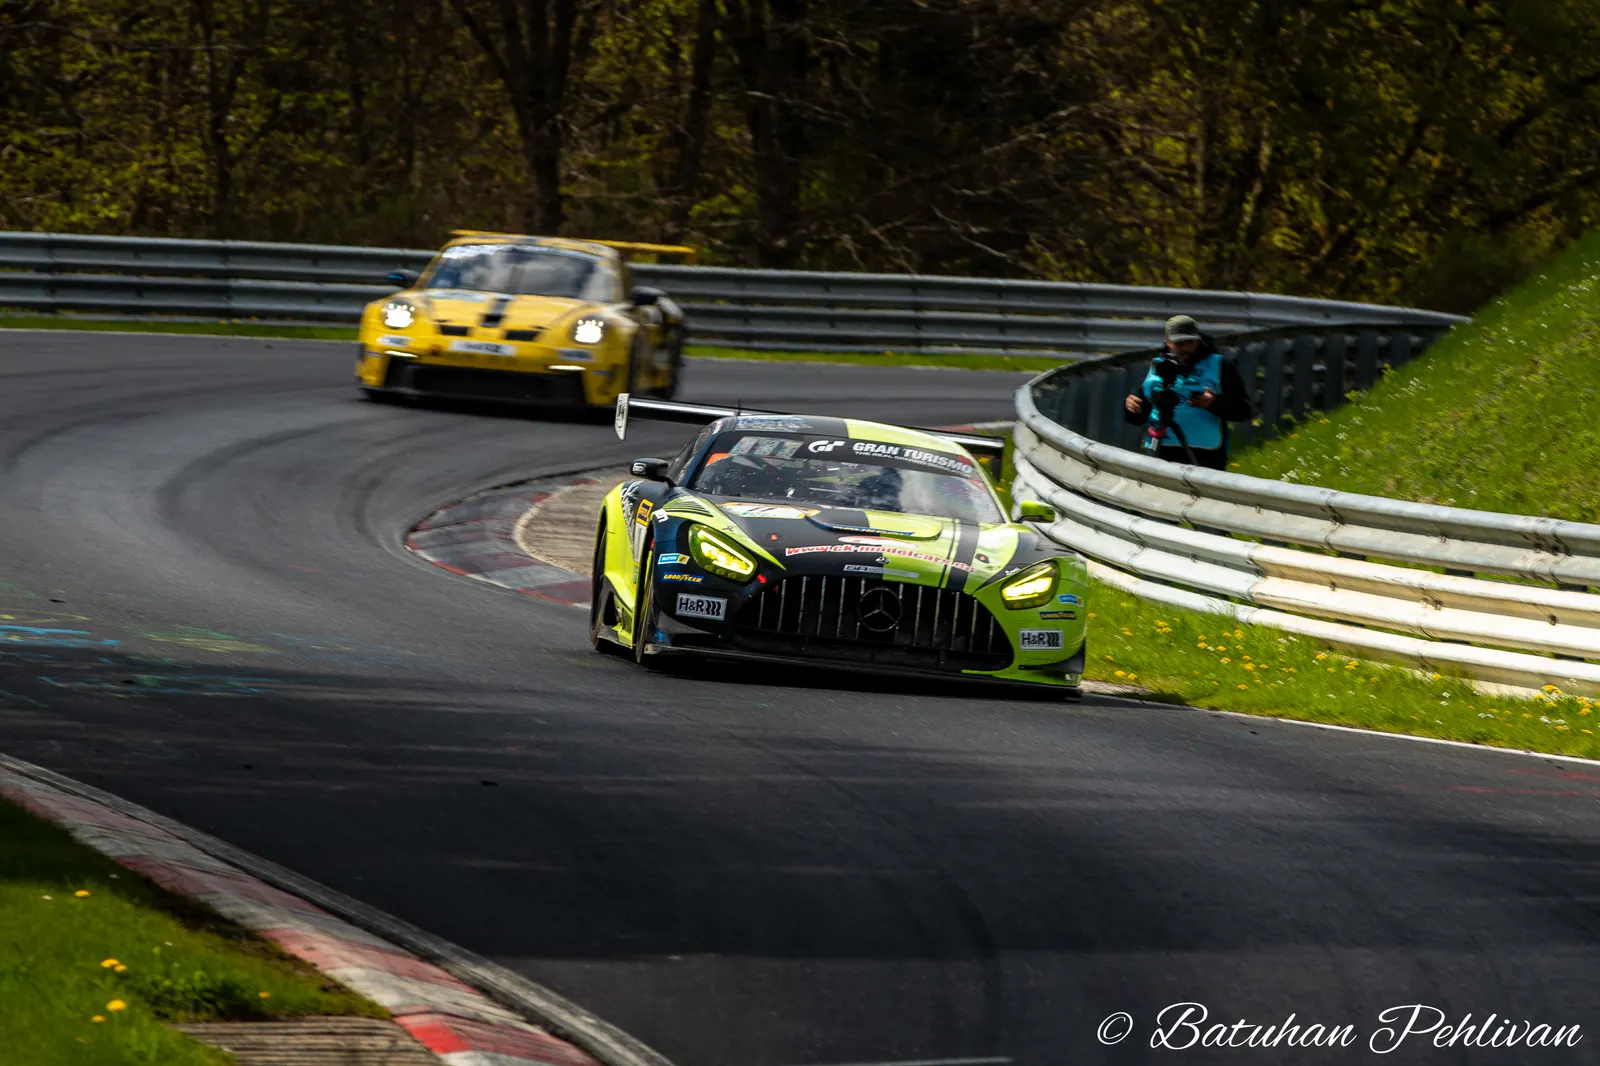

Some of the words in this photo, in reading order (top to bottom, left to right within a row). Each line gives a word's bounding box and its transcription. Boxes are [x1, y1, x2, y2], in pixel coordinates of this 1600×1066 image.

[853, 442, 900, 456] GRAN
[902, 448, 975, 475] TURISMO
[663, 574, 703, 583] GOODYEAR
[679, 597, 705, 613] H&R
[1021, 632, 1047, 646] H&R
